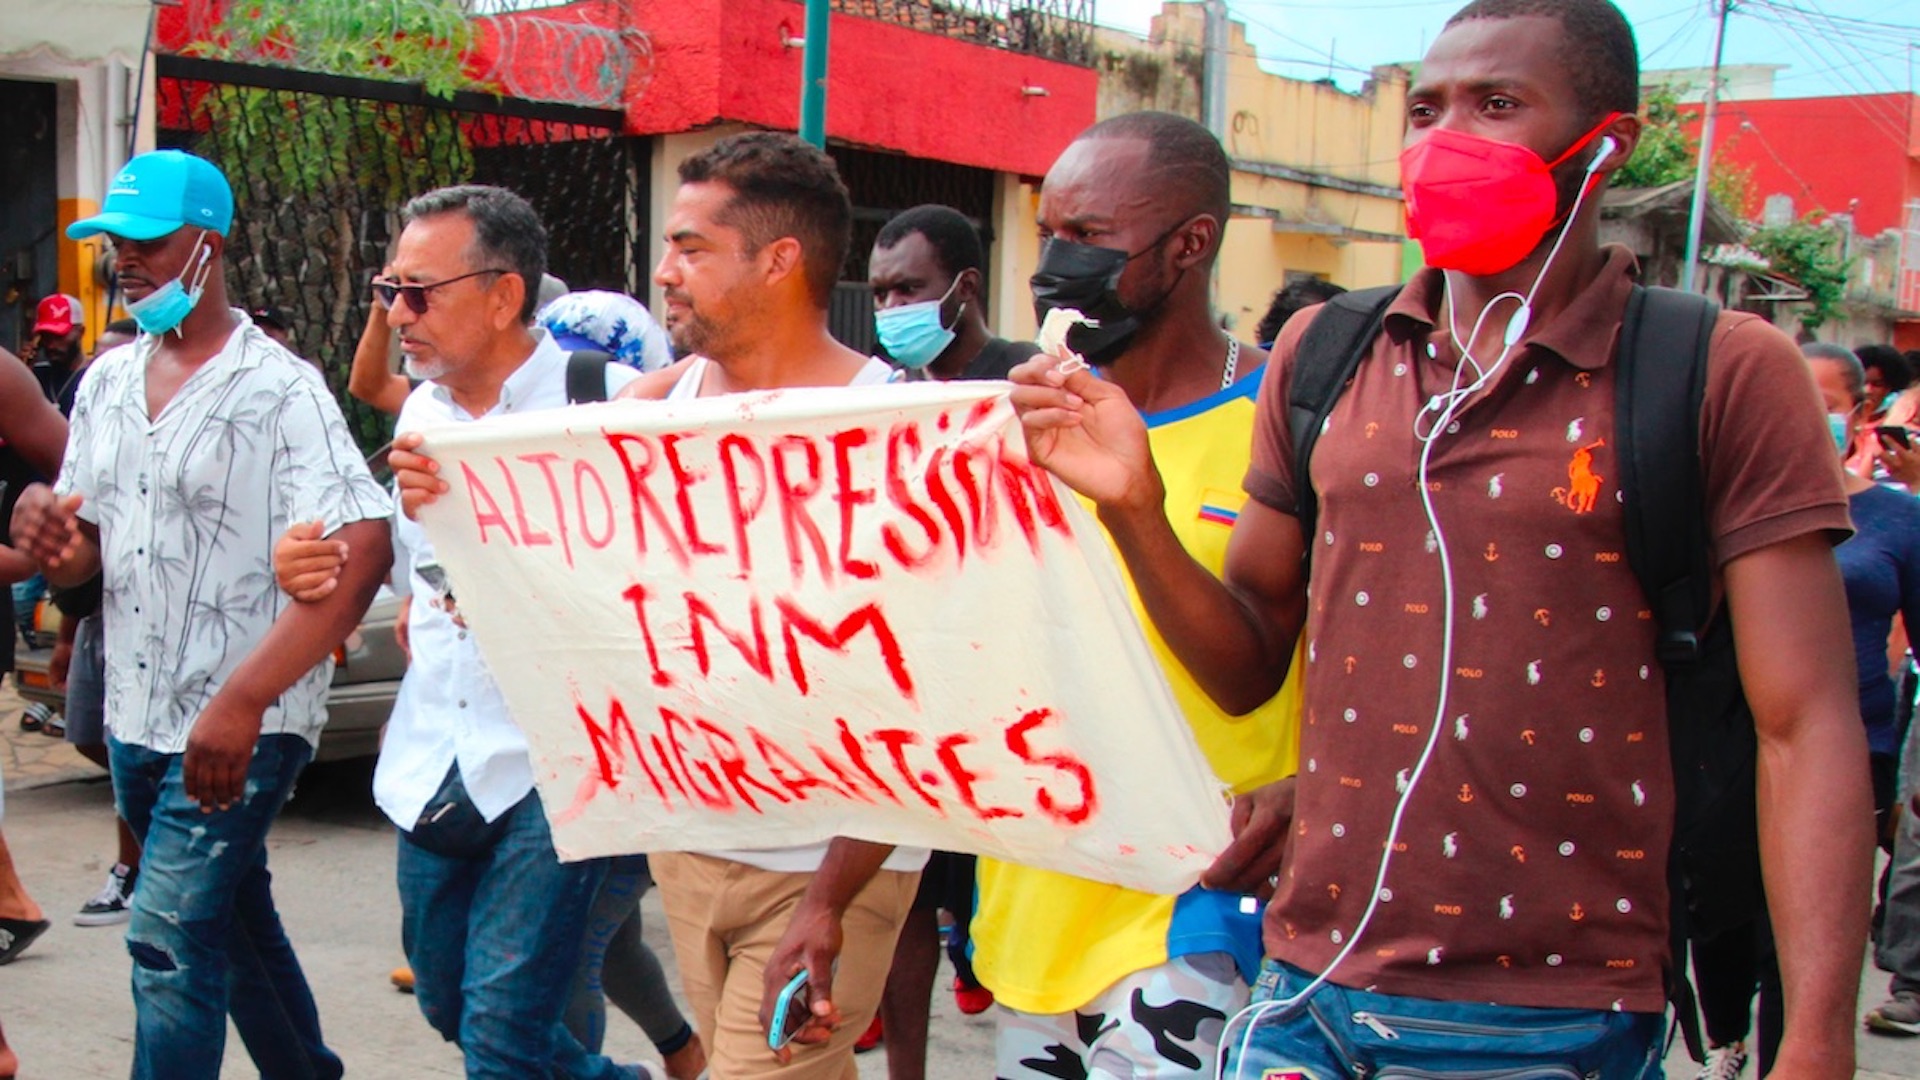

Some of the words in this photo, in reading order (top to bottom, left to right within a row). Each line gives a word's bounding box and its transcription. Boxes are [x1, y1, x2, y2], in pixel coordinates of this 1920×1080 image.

[1490, 429, 1519, 439] POLO
[460, 453, 615, 569] ALTO
[1359, 542, 1384, 552] POLO
[1594, 552, 1620, 563] POLO
[1405, 603, 1429, 614] POLO
[622, 582, 919, 709] INM
[1456, 667, 1483, 678] POLO
[1392, 723, 1419, 735] POLO
[1566, 793, 1595, 803] POLO
[1616, 849, 1645, 860] POLO
[1434, 904, 1462, 915] POLO
